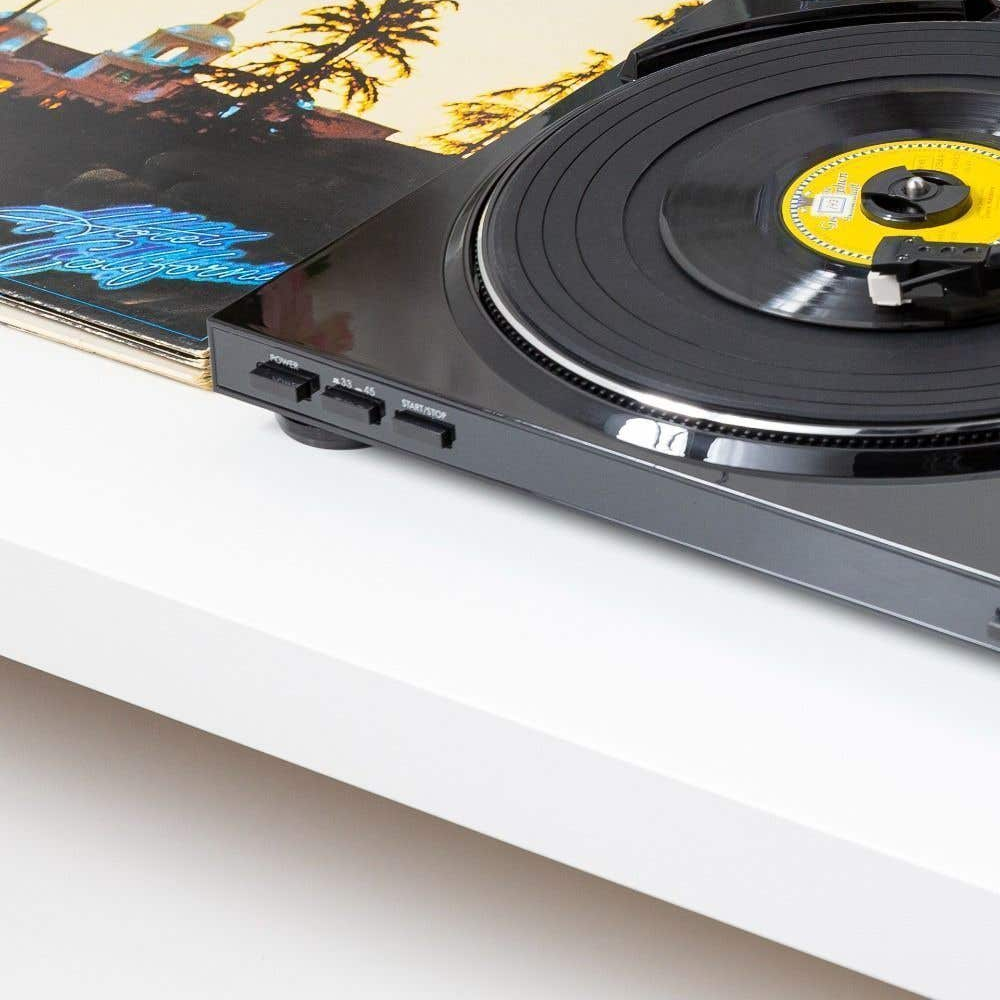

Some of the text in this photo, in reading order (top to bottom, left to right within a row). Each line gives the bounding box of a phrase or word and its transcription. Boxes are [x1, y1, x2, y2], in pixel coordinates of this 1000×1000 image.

[0, 239, 290, 286] Californi
[269, 353, 299, 370] POWER
[339, 377, 377, 397] 33 45
[401, 398, 447, 420] START/STOP
